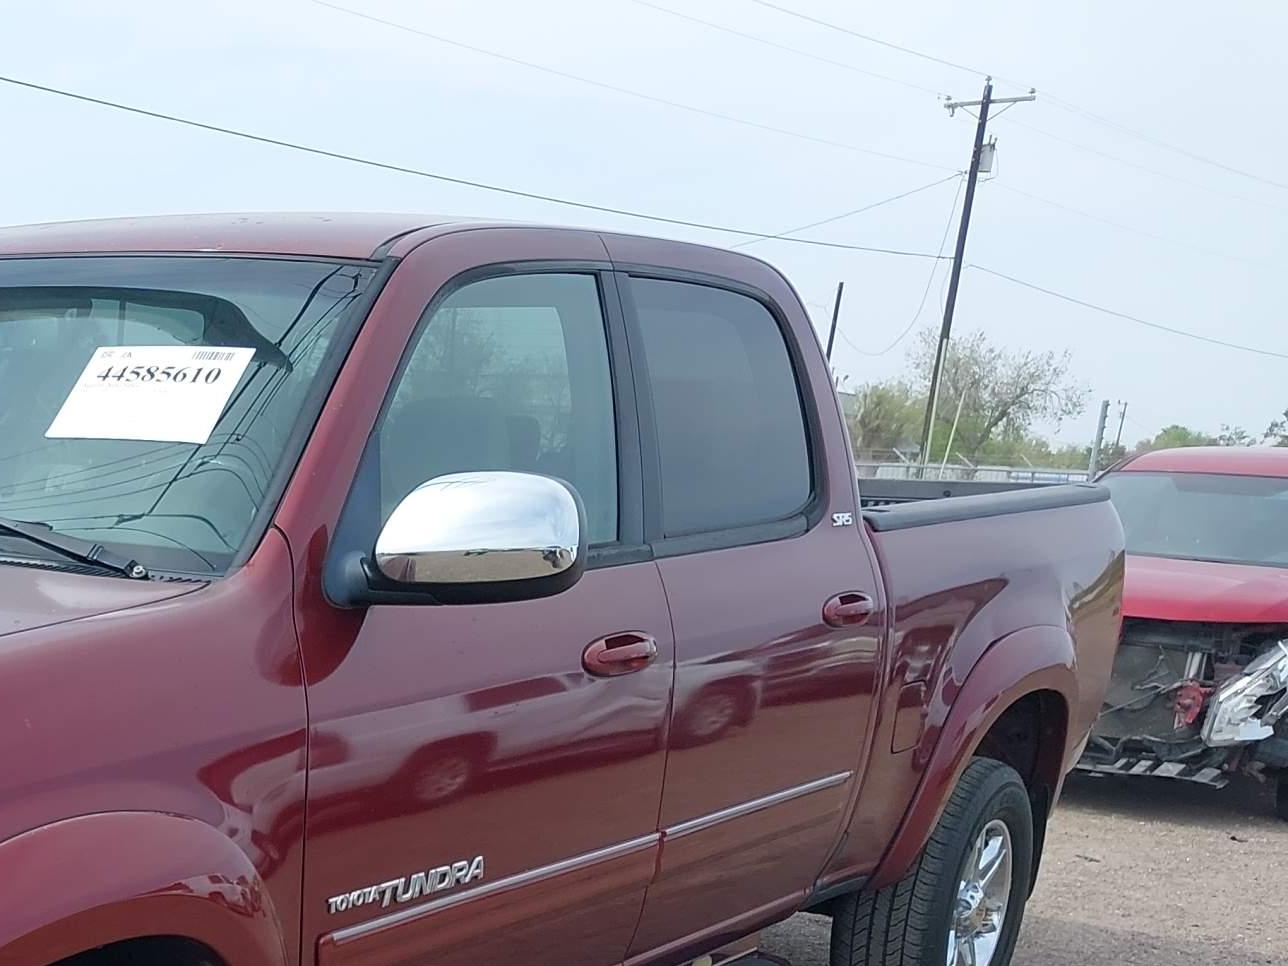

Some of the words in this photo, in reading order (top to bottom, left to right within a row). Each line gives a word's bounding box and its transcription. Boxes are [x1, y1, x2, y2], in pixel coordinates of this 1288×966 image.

[96, 365, 222, 385] 44585610
[831, 511, 853, 527] SR5
[327, 885, 381, 914] TOYOTA
[380, 855, 484, 908] TUNDRA
